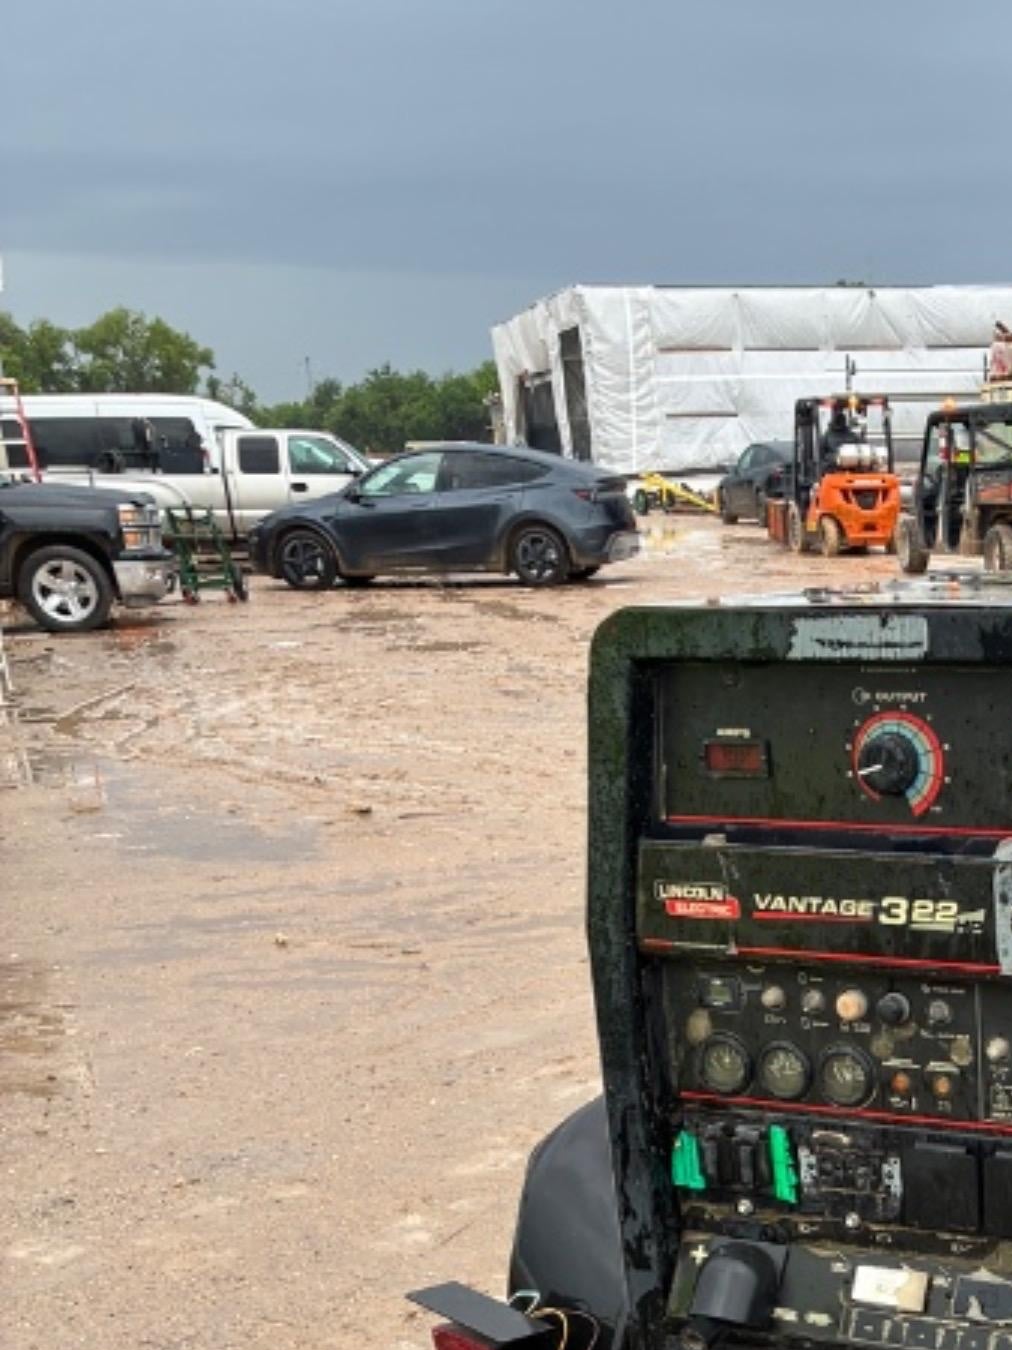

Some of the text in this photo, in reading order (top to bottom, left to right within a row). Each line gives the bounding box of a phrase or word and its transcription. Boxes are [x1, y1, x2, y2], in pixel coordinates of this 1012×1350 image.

[659, 884, 724, 900] LINCOLN
[675, 902, 733, 915] ELECTRIC
[753, 893, 958, 924] VANTAGE 322
